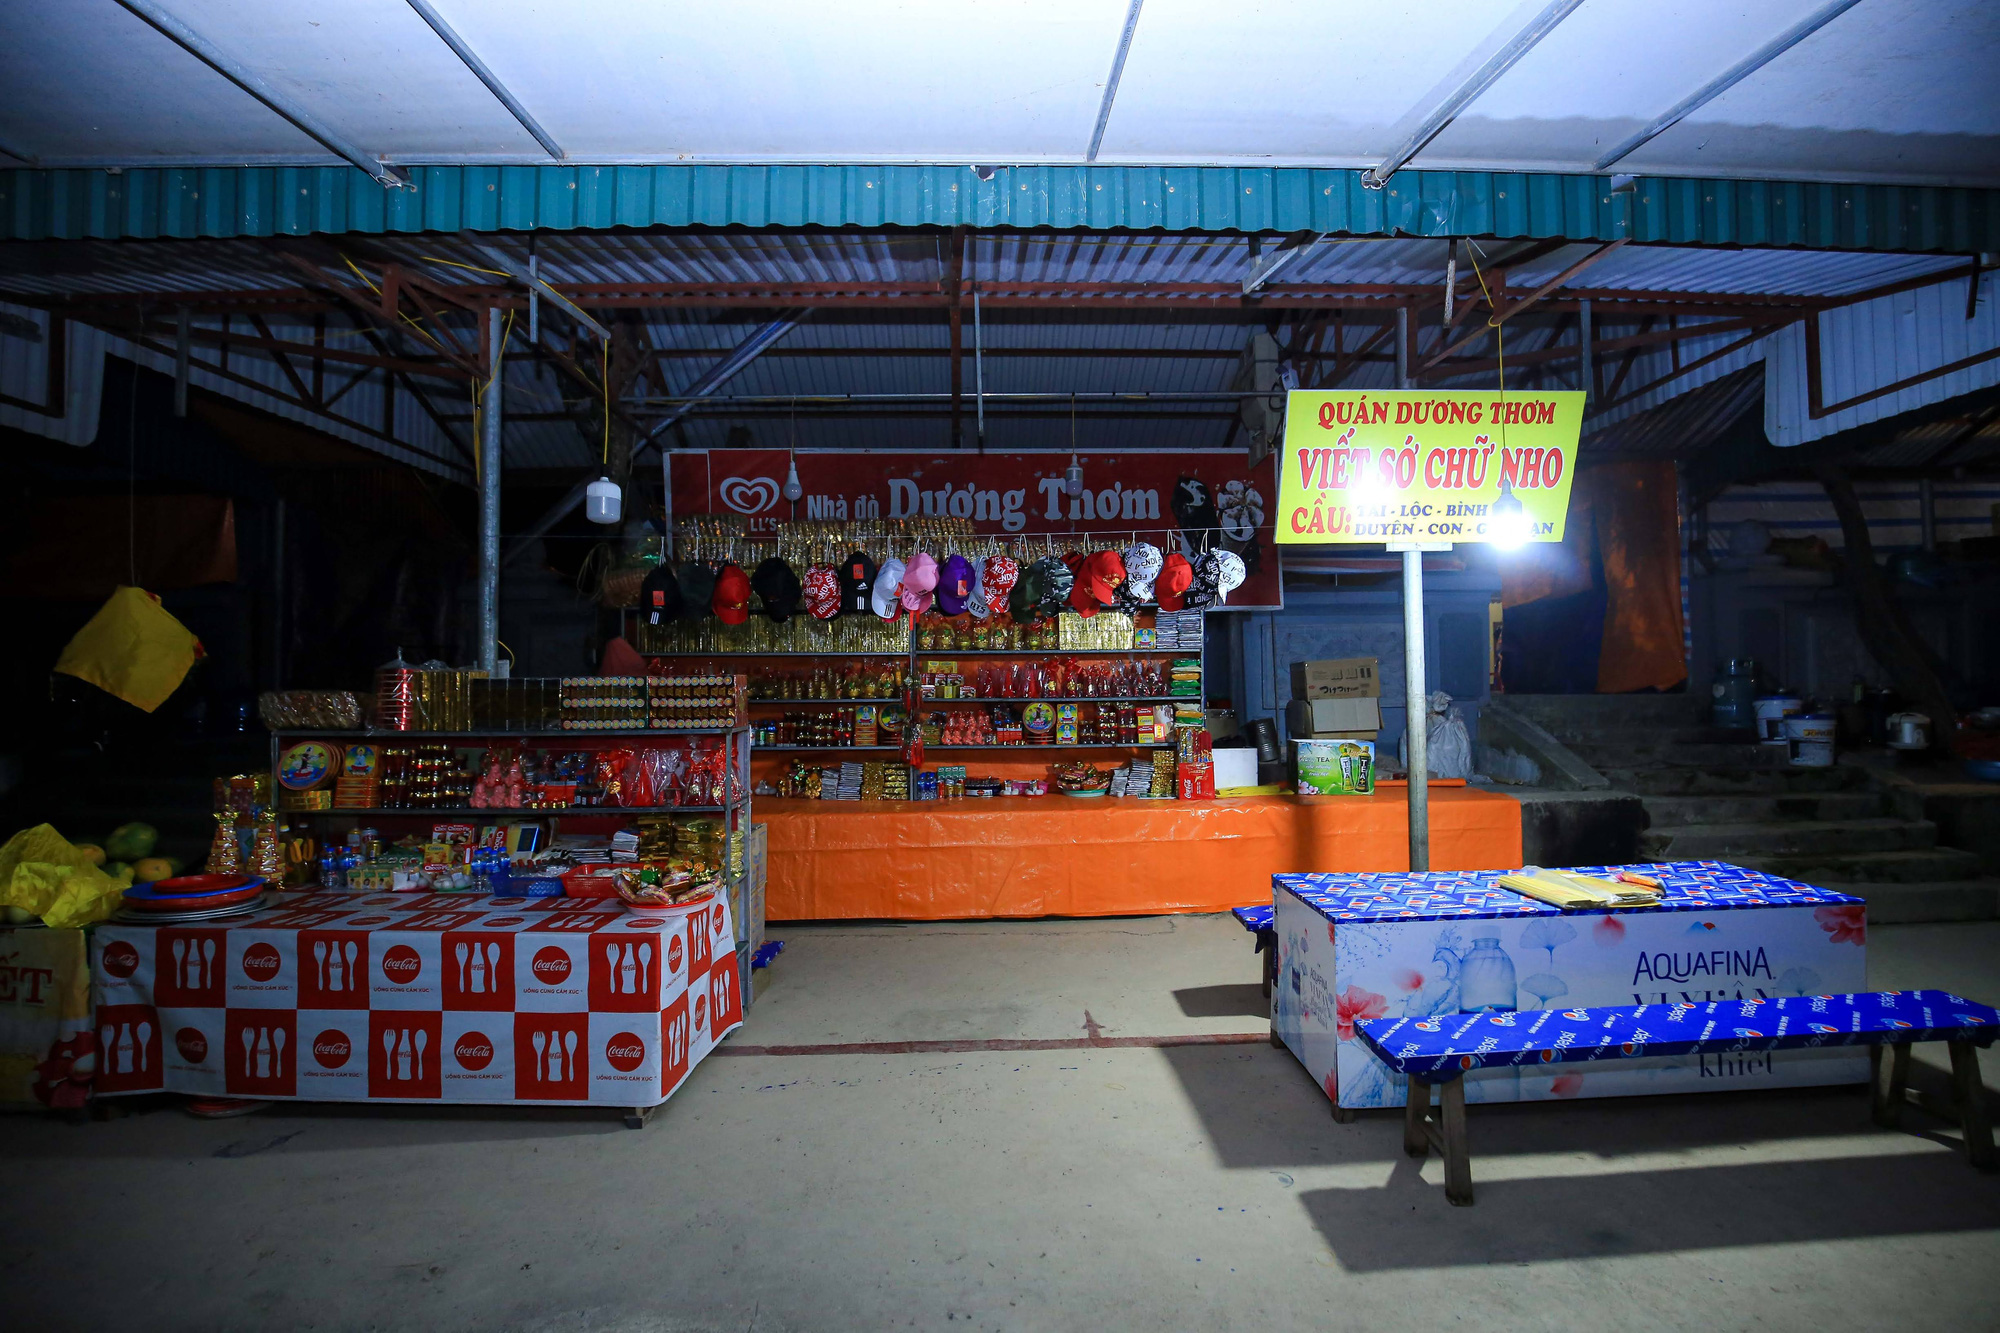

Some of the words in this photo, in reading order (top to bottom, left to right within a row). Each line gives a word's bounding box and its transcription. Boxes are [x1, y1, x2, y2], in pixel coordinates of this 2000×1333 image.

[1318, 395, 1390, 430] QUÁN
[1395, 399, 1483, 425] DƯƠNG
[1490, 399, 1557, 425] THƠM
[1297, 428, 1371, 490] VIẾT
[1377, 434, 1420, 490] SỚ
[1424, 435, 1496, 489] CHỮ
[1496, 447, 1564, 490] NHO
[806, 494, 848, 521] Nhà
[887, 478, 1027, 532] Dương
[1038, 478, 1161, 521] Thơm
[1291, 492, 1352, 534] CẦU:
[1400, 501, 1433, 519] LỘC
[1446, 500, 1488, 517] BÌNH
[1354, 520, 1415, 536] DUYÊN
[1428, 522, 1463, 535] CON
[244, 956, 279, 968] Coca-Cola
[384, 957, 420, 971] Coca-Cola
[533, 959, 570, 972] Coca-Cola
[1632, 946, 1772, 985] AQUAFINA
[314, 1042, 350, 1055] Coca-Cola
[456, 1044, 492, 1057] Coca-Cola
[608, 1045, 644, 1058] Coca-Cola
